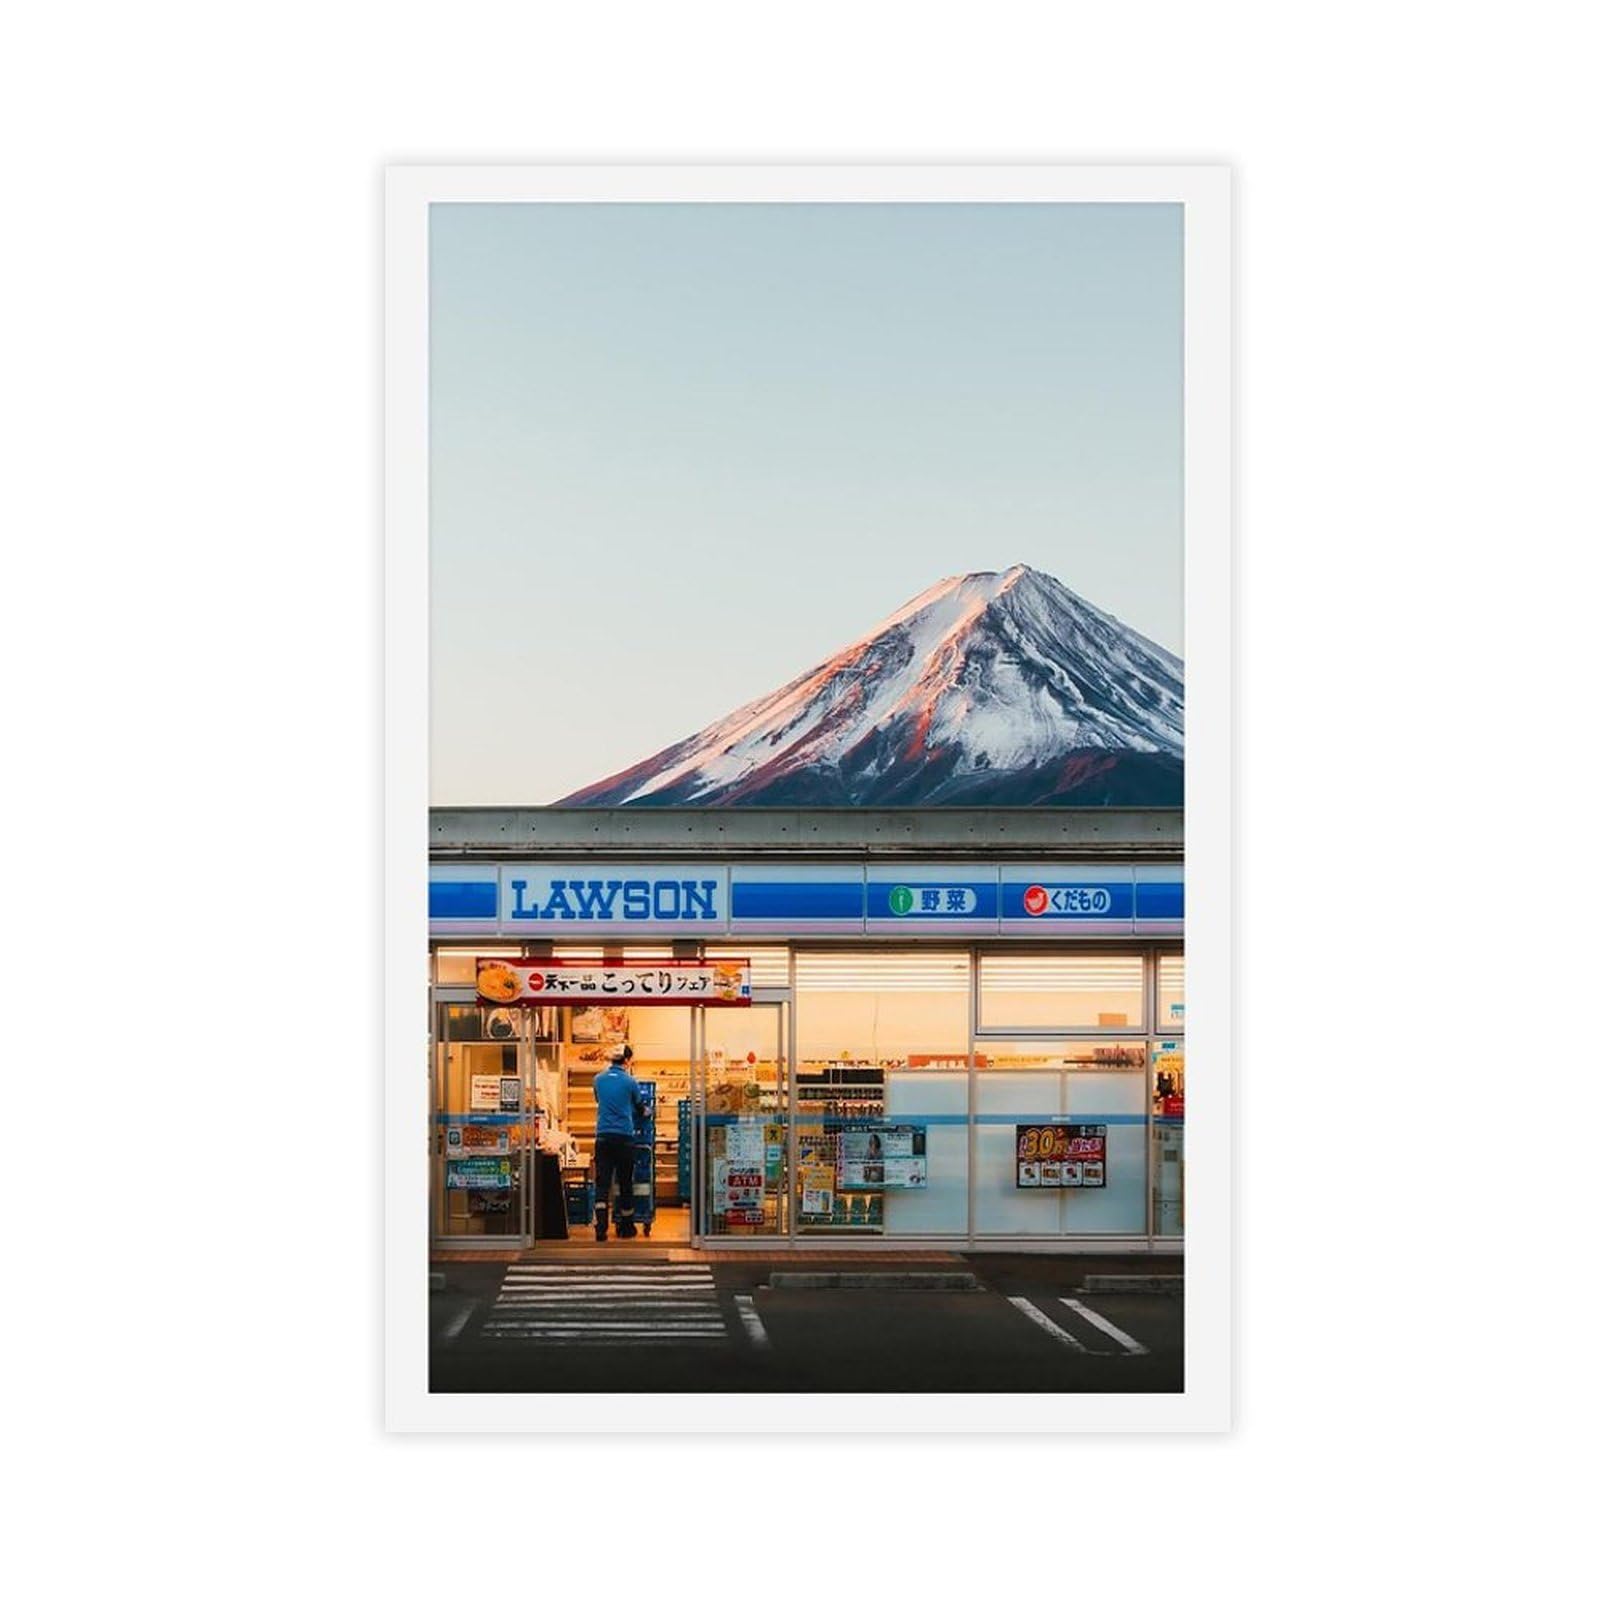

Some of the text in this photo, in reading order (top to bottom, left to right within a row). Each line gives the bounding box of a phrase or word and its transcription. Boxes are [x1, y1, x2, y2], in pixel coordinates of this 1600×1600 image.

[511, 880, 718, 919] LAWSON
[920, 890, 967, 911] 野菜
[1050, 890, 1107, 911] くだもの
[732, 1176, 759, 1185] ATM
